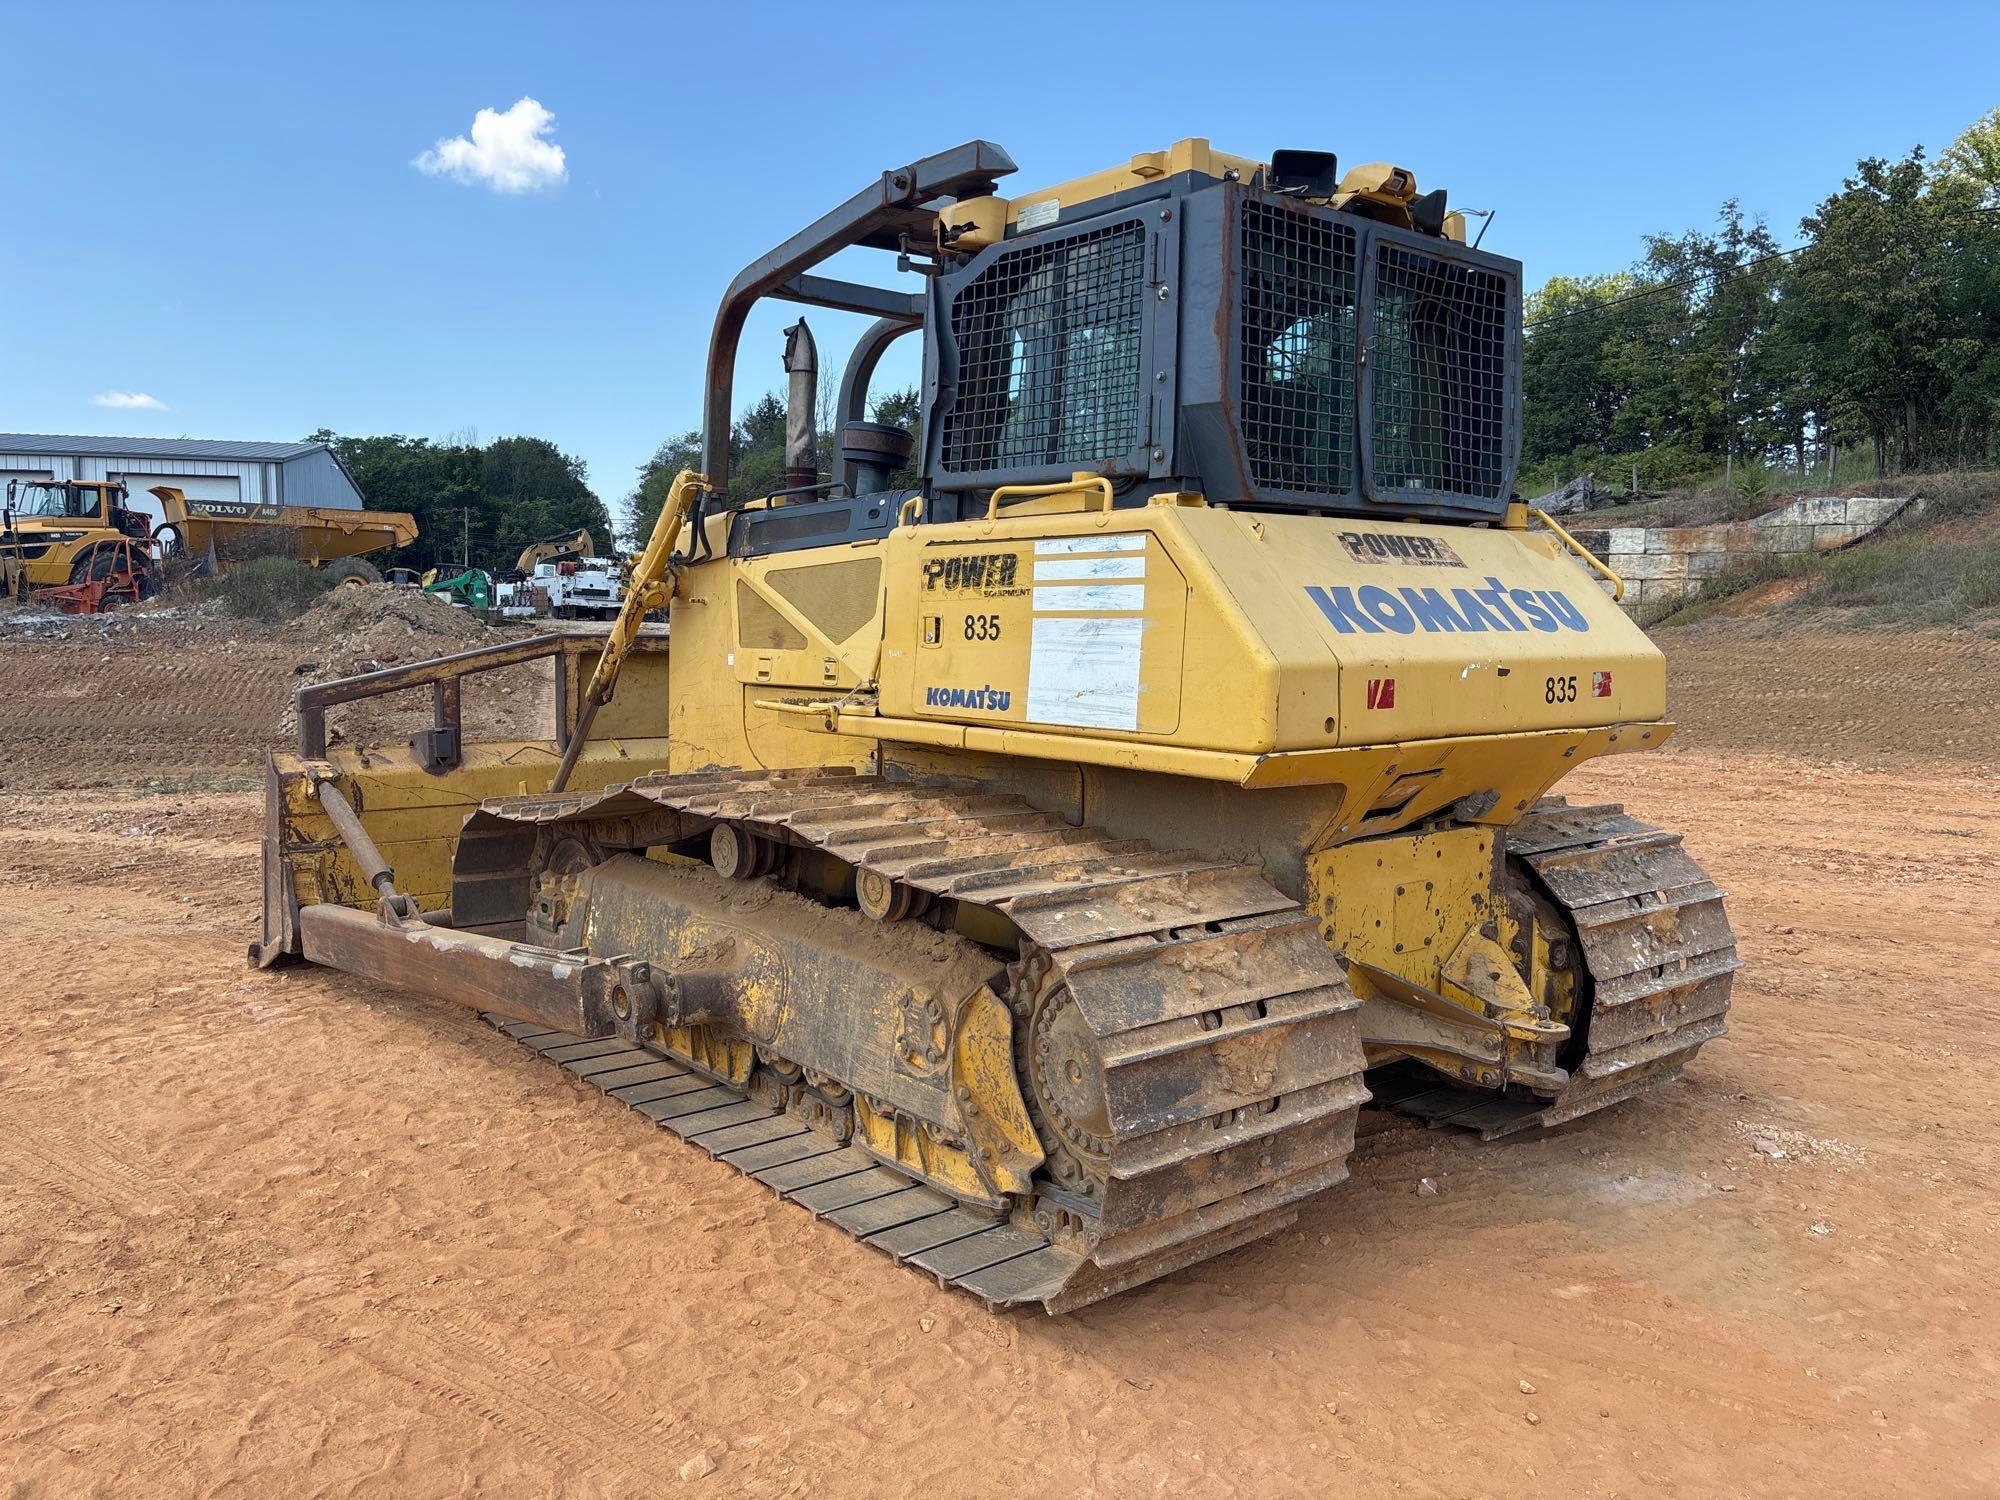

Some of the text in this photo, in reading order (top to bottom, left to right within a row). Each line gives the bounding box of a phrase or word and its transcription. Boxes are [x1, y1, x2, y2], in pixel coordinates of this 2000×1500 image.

[192, 503, 247, 515] VOLVO
[1337, 531, 1444, 559] POWER
[923, 553, 1017, 590] POWER
[1304, 576, 1590, 634] KOMATSU
[964, 614, 1000, 641] 835
[926, 684, 1011, 711] KOMATSU
[1545, 676, 1577, 704] 835
